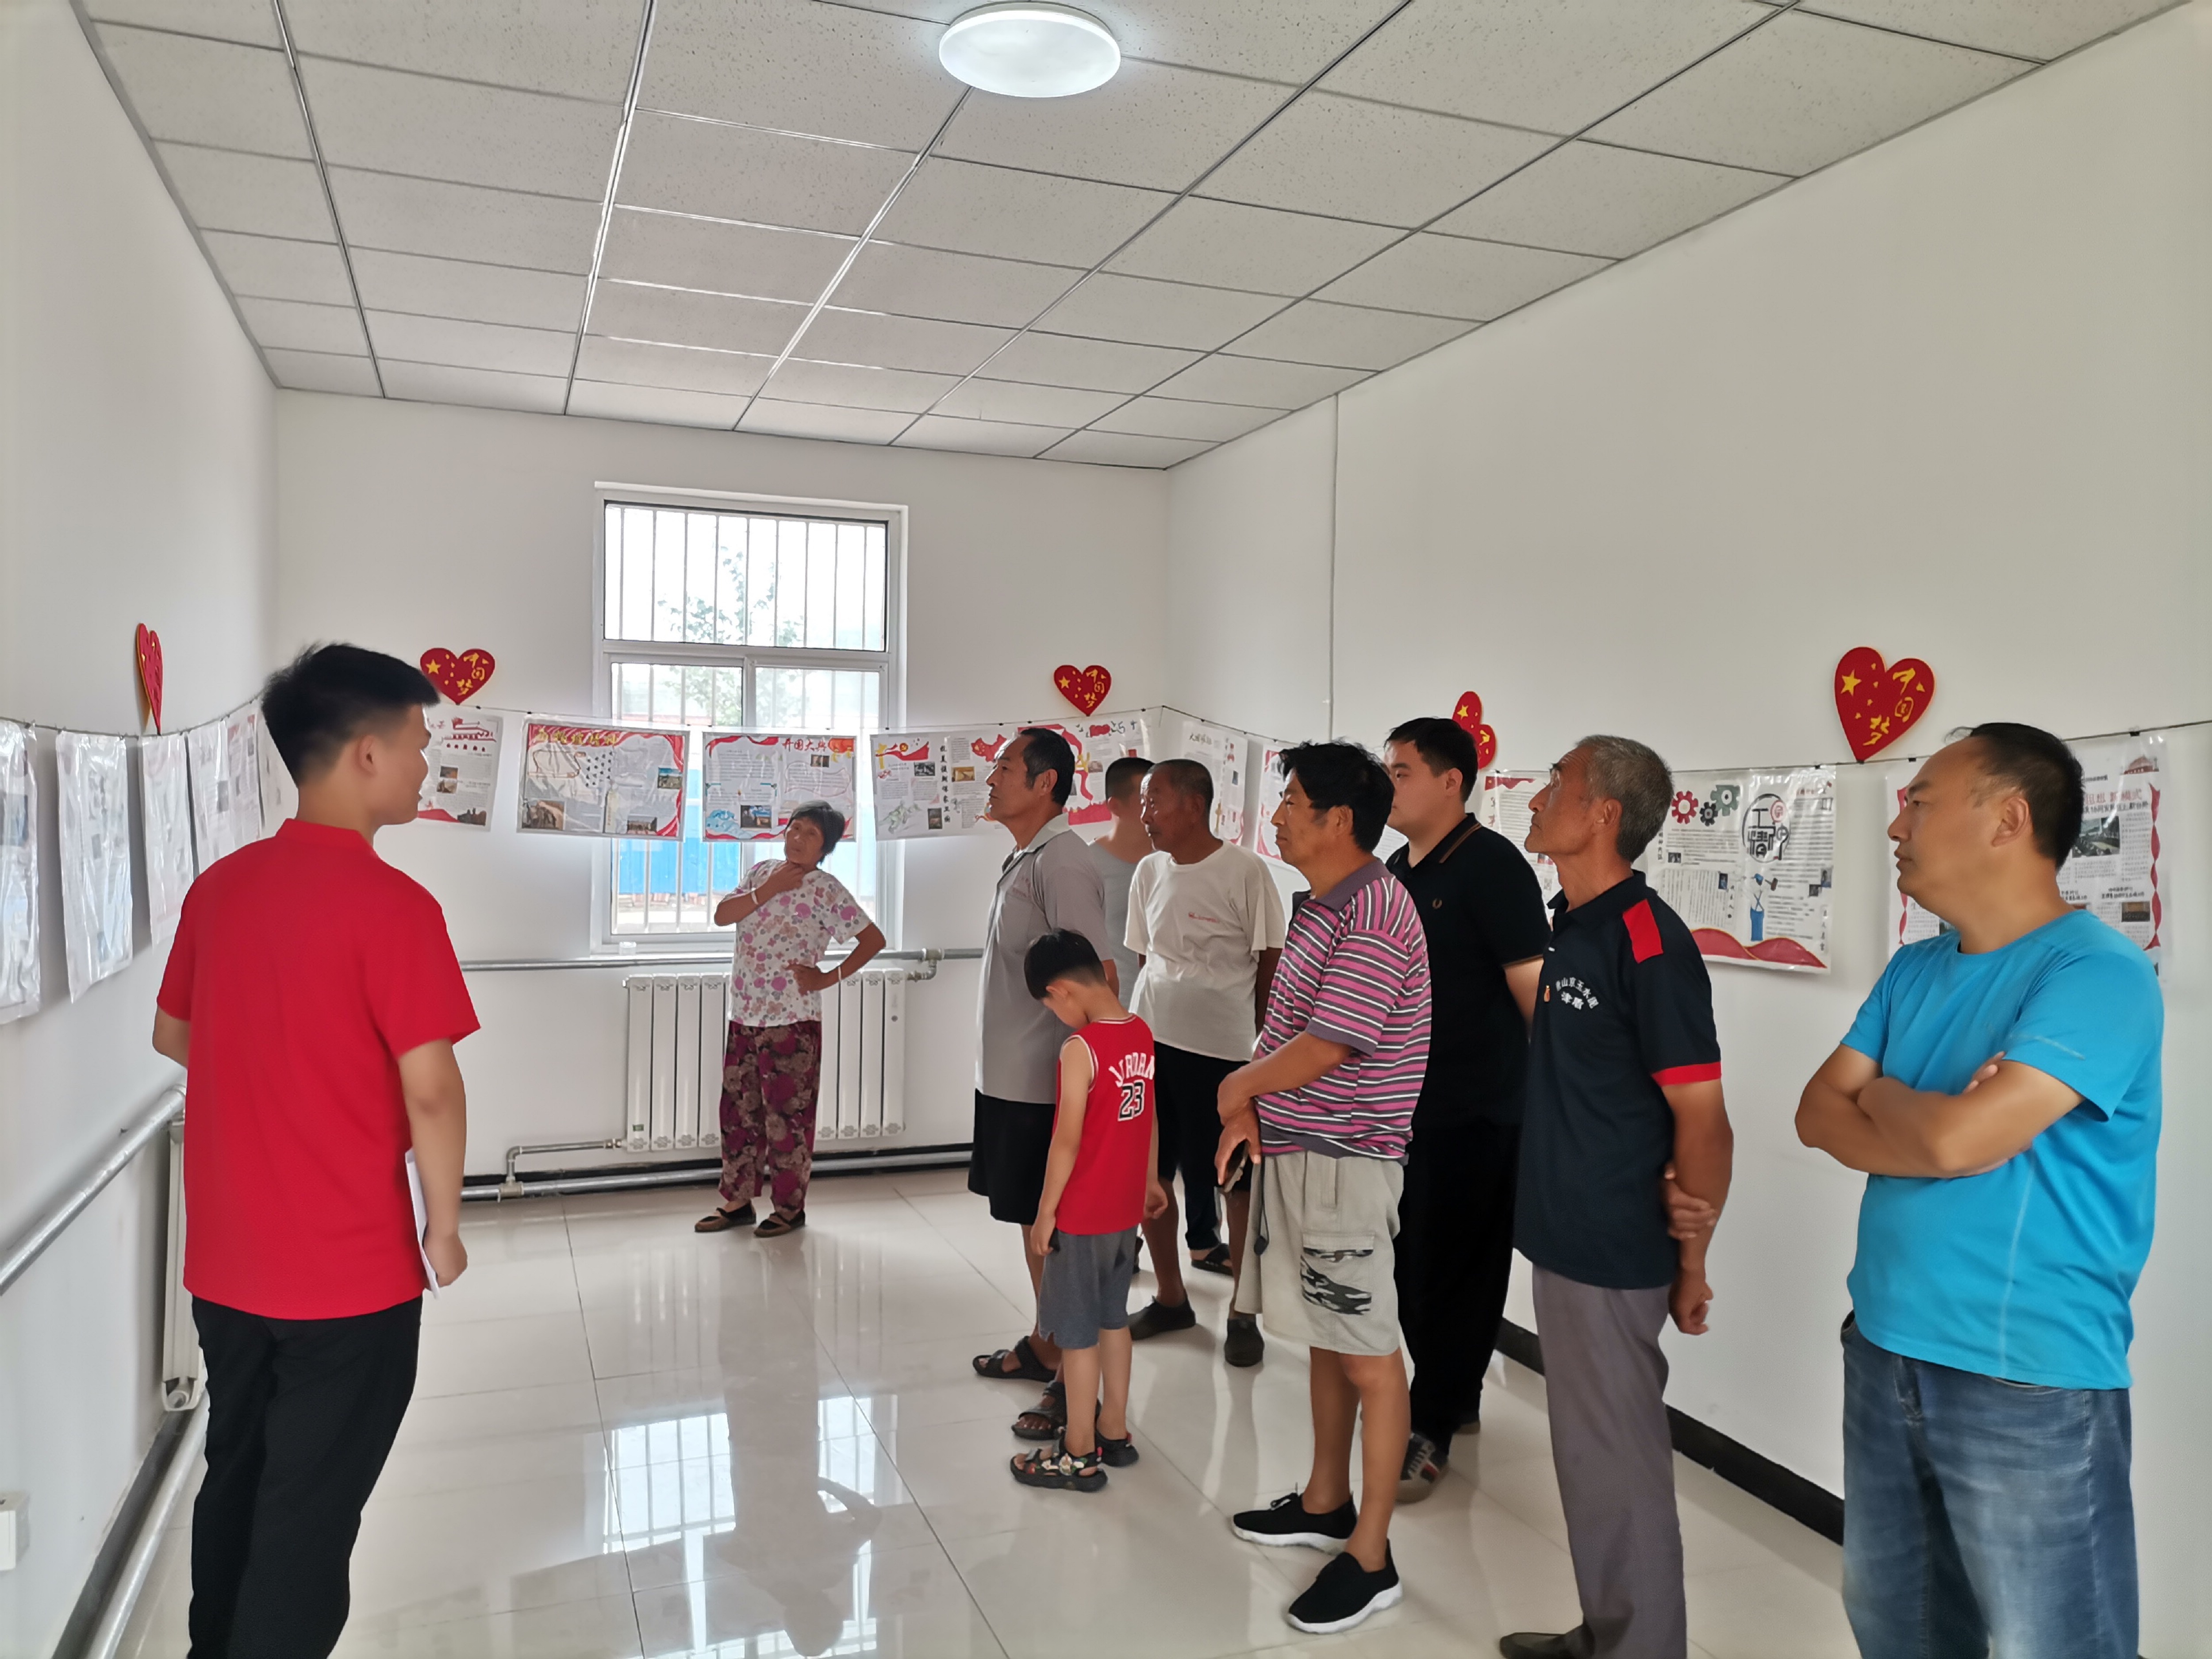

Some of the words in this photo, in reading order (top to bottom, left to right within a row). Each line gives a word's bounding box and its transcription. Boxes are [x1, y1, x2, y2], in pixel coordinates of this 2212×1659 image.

[782, 737, 828, 752] 开国大典
[1118, 1079, 1145, 1122] 23
